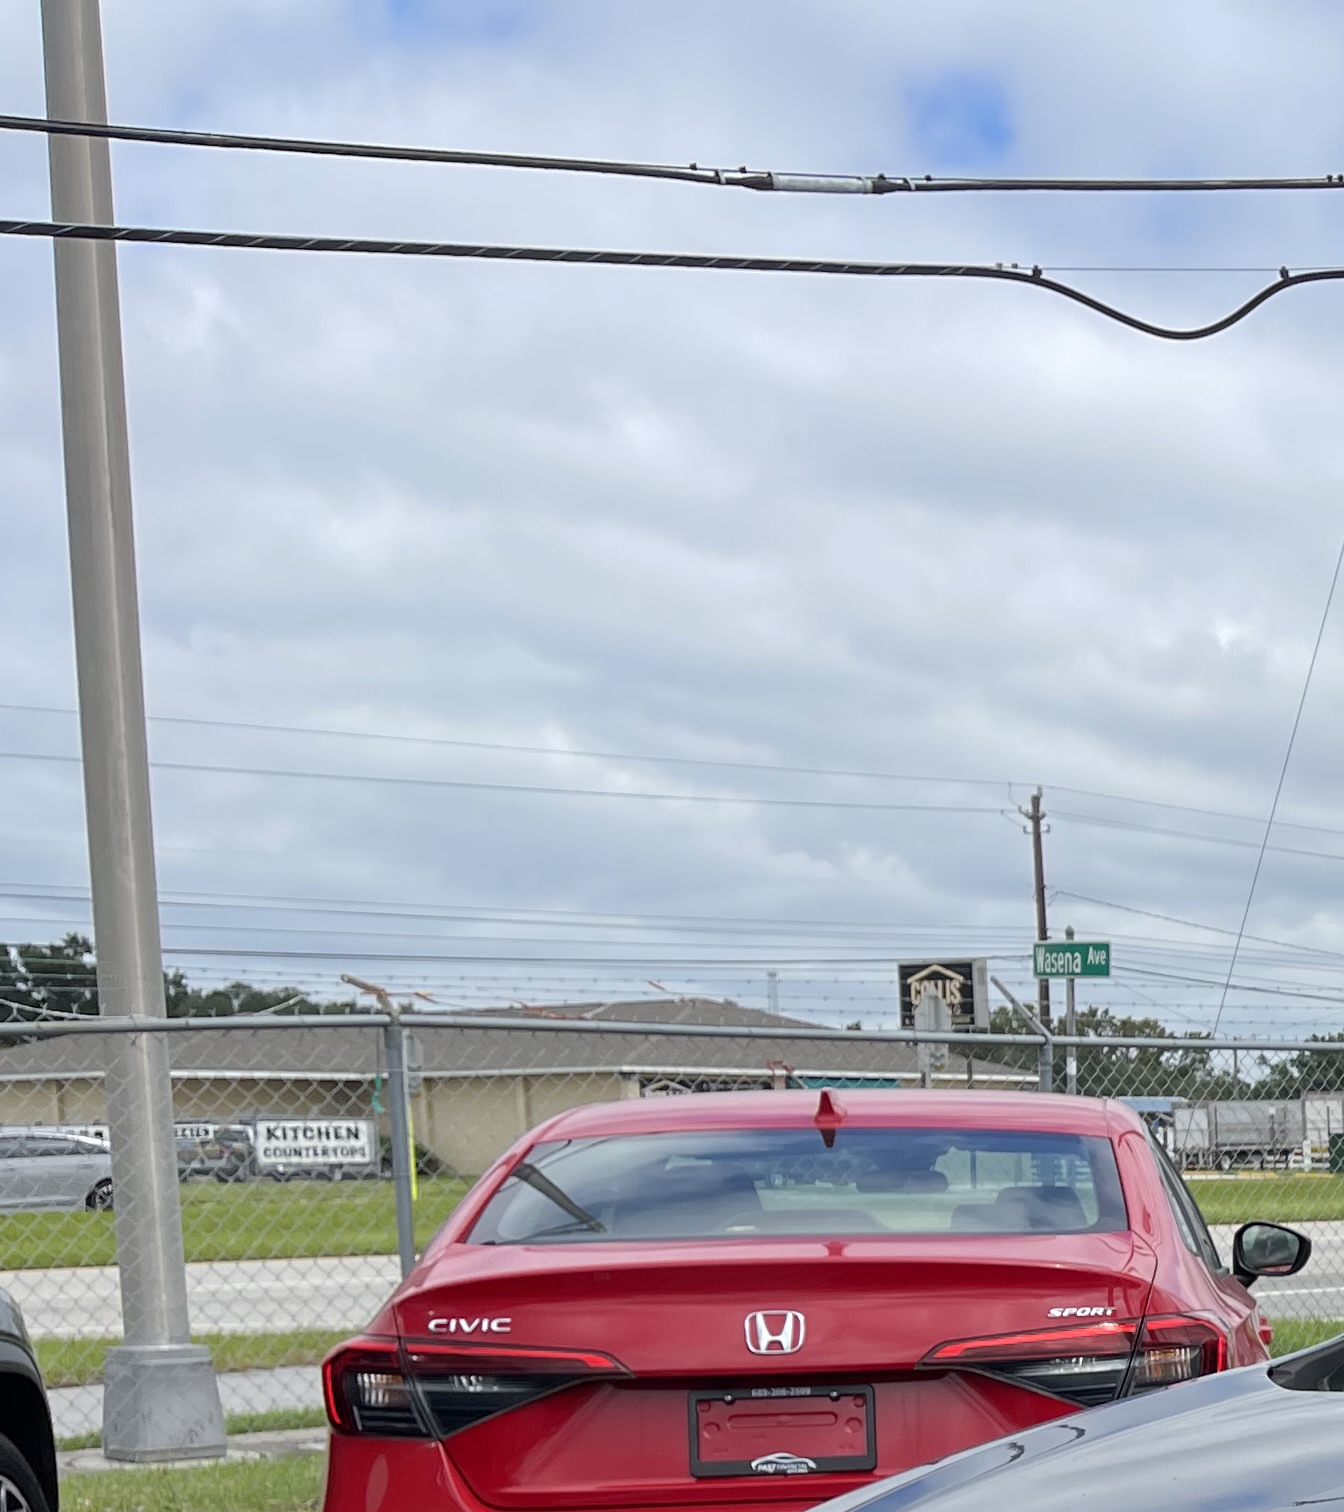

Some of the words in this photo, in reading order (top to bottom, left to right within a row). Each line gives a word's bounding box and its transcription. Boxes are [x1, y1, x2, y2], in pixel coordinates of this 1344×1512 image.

[1035, 946, 1082, 974] Wasena
[1086, 945, 1107, 966] Ave
[266, 1125, 360, 1140] KITCHEN
[1047, 1305, 1118, 1318] SPORT
[427, 1317, 512, 1334] CIVIC
